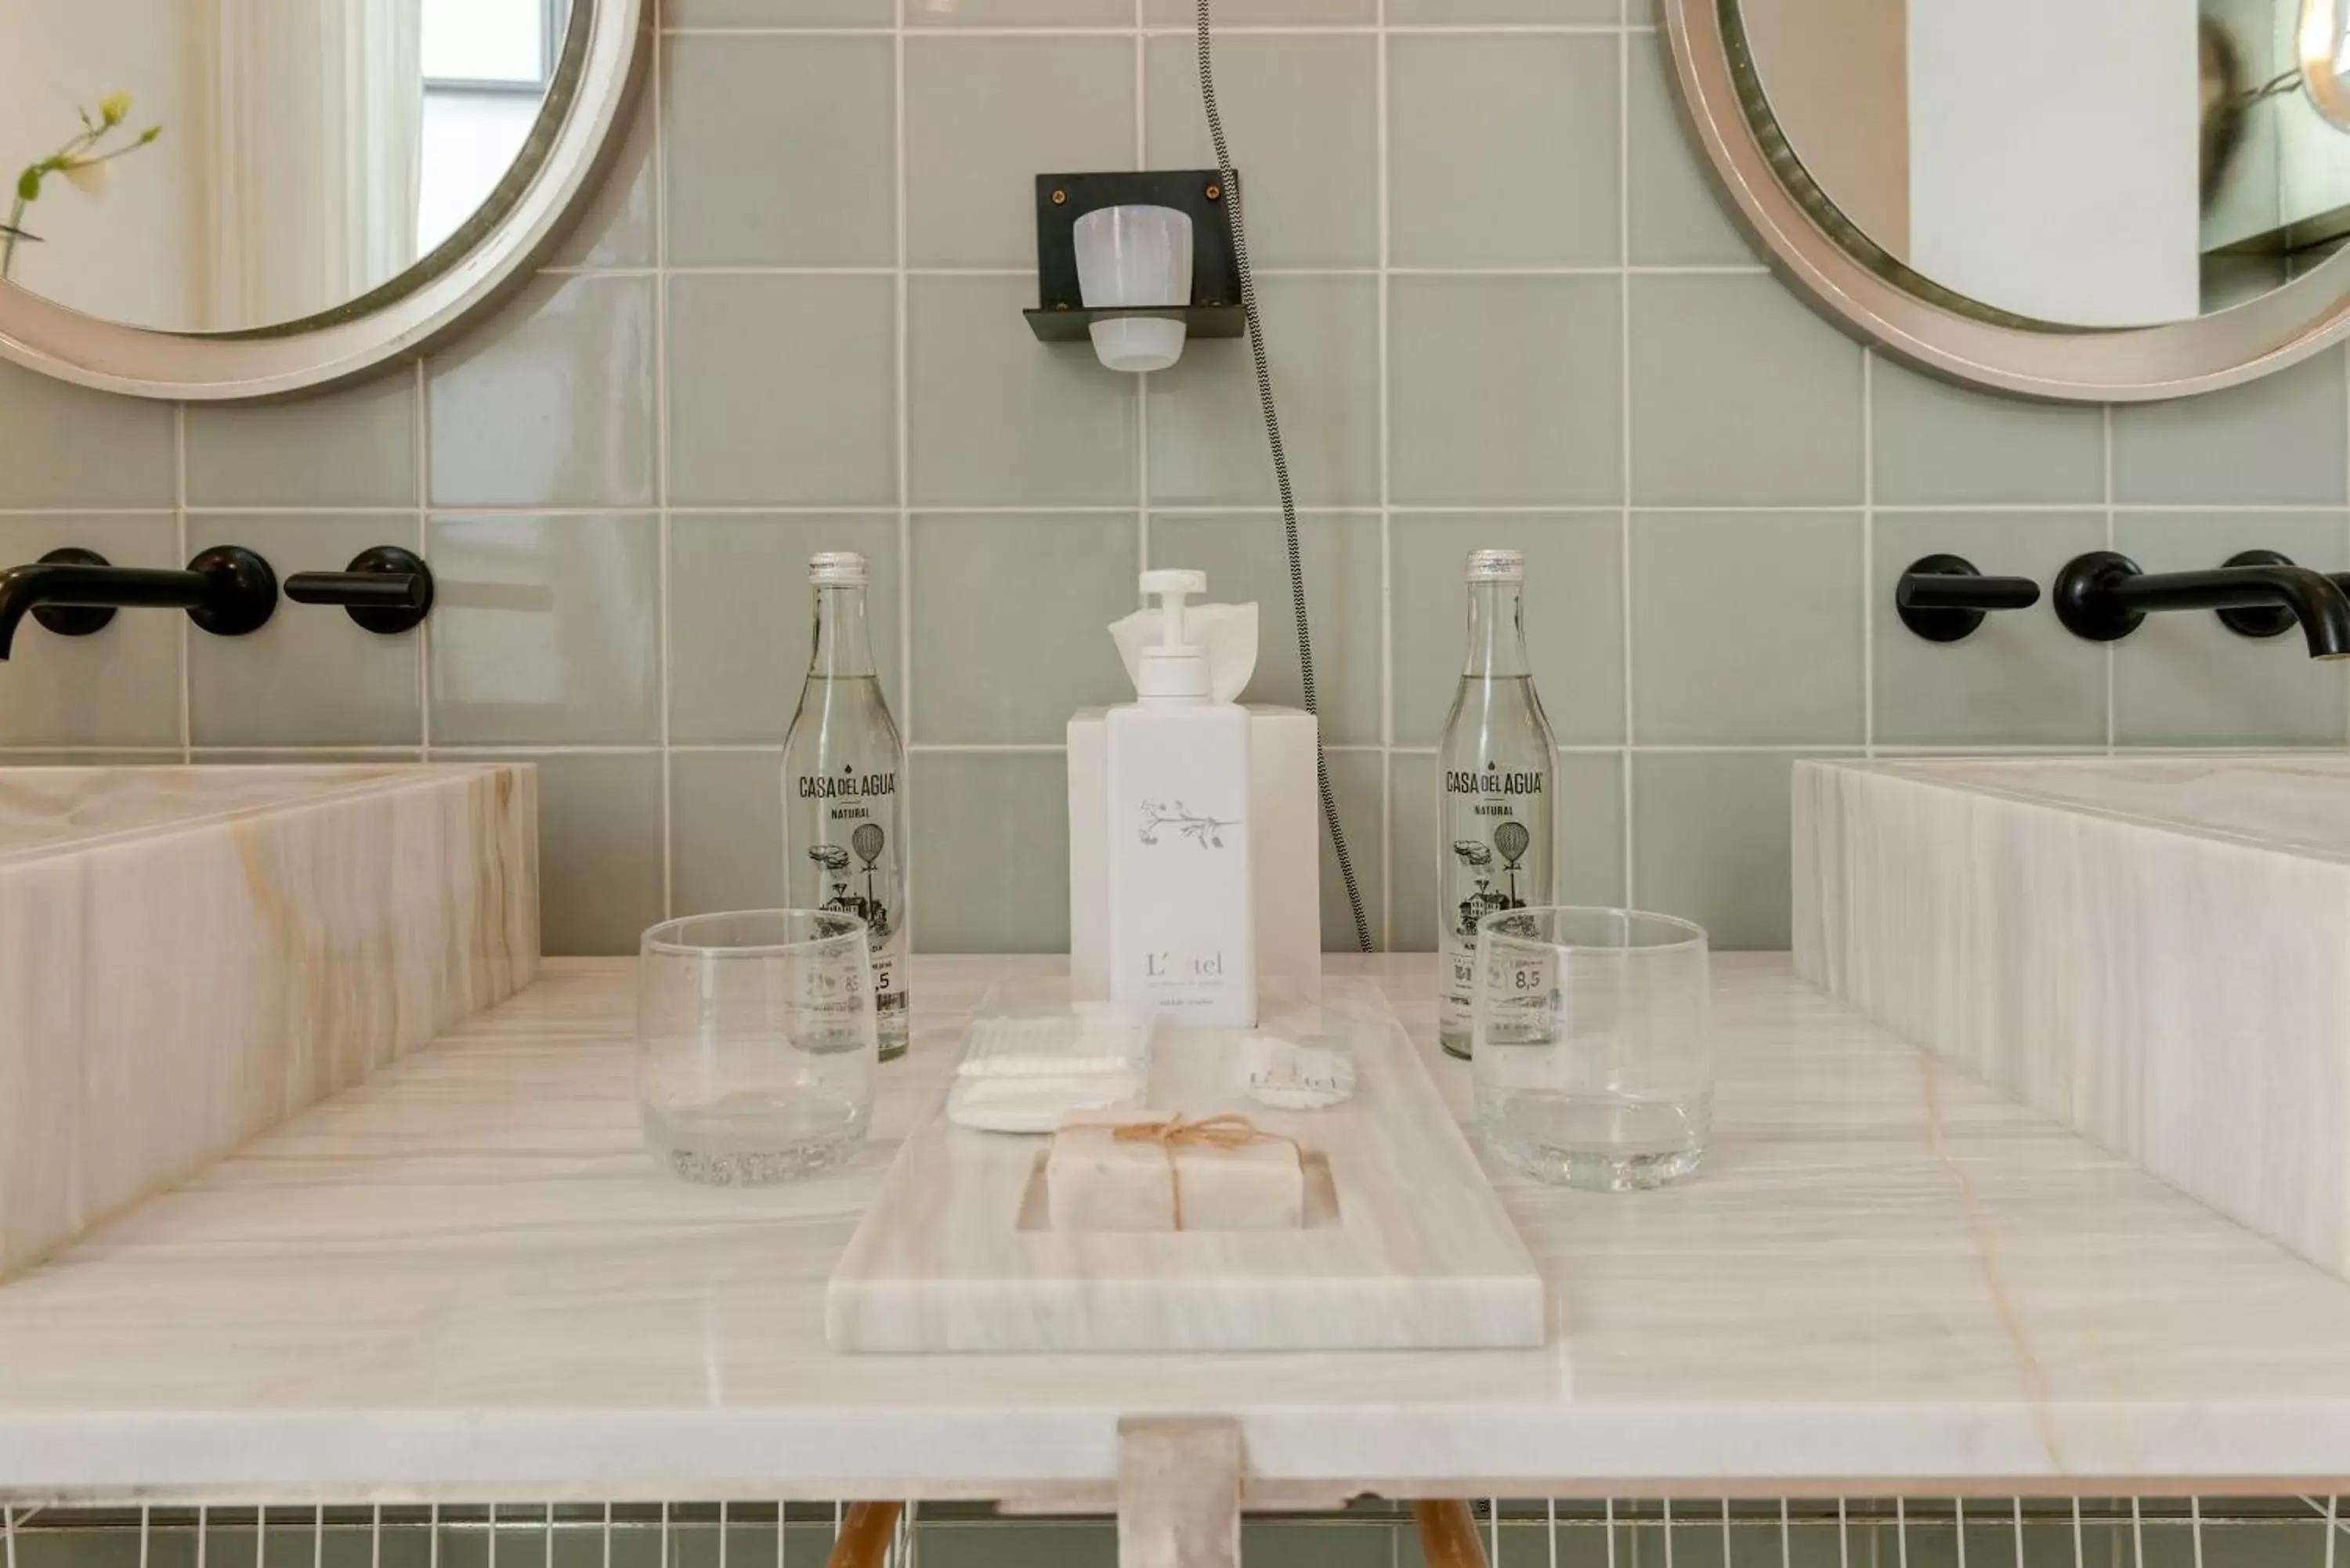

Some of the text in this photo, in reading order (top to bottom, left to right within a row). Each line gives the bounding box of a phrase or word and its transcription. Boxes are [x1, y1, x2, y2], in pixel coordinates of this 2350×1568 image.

[799, 774, 895, 798] CASA DEL AGUA
[1447, 771, 1542, 795] CASA DEL AGUA
[831, 807, 870, 820] NATURAL
[1474, 805, 1513, 816] NATURAL
[1516, 970, 1541, 991] 8,5
